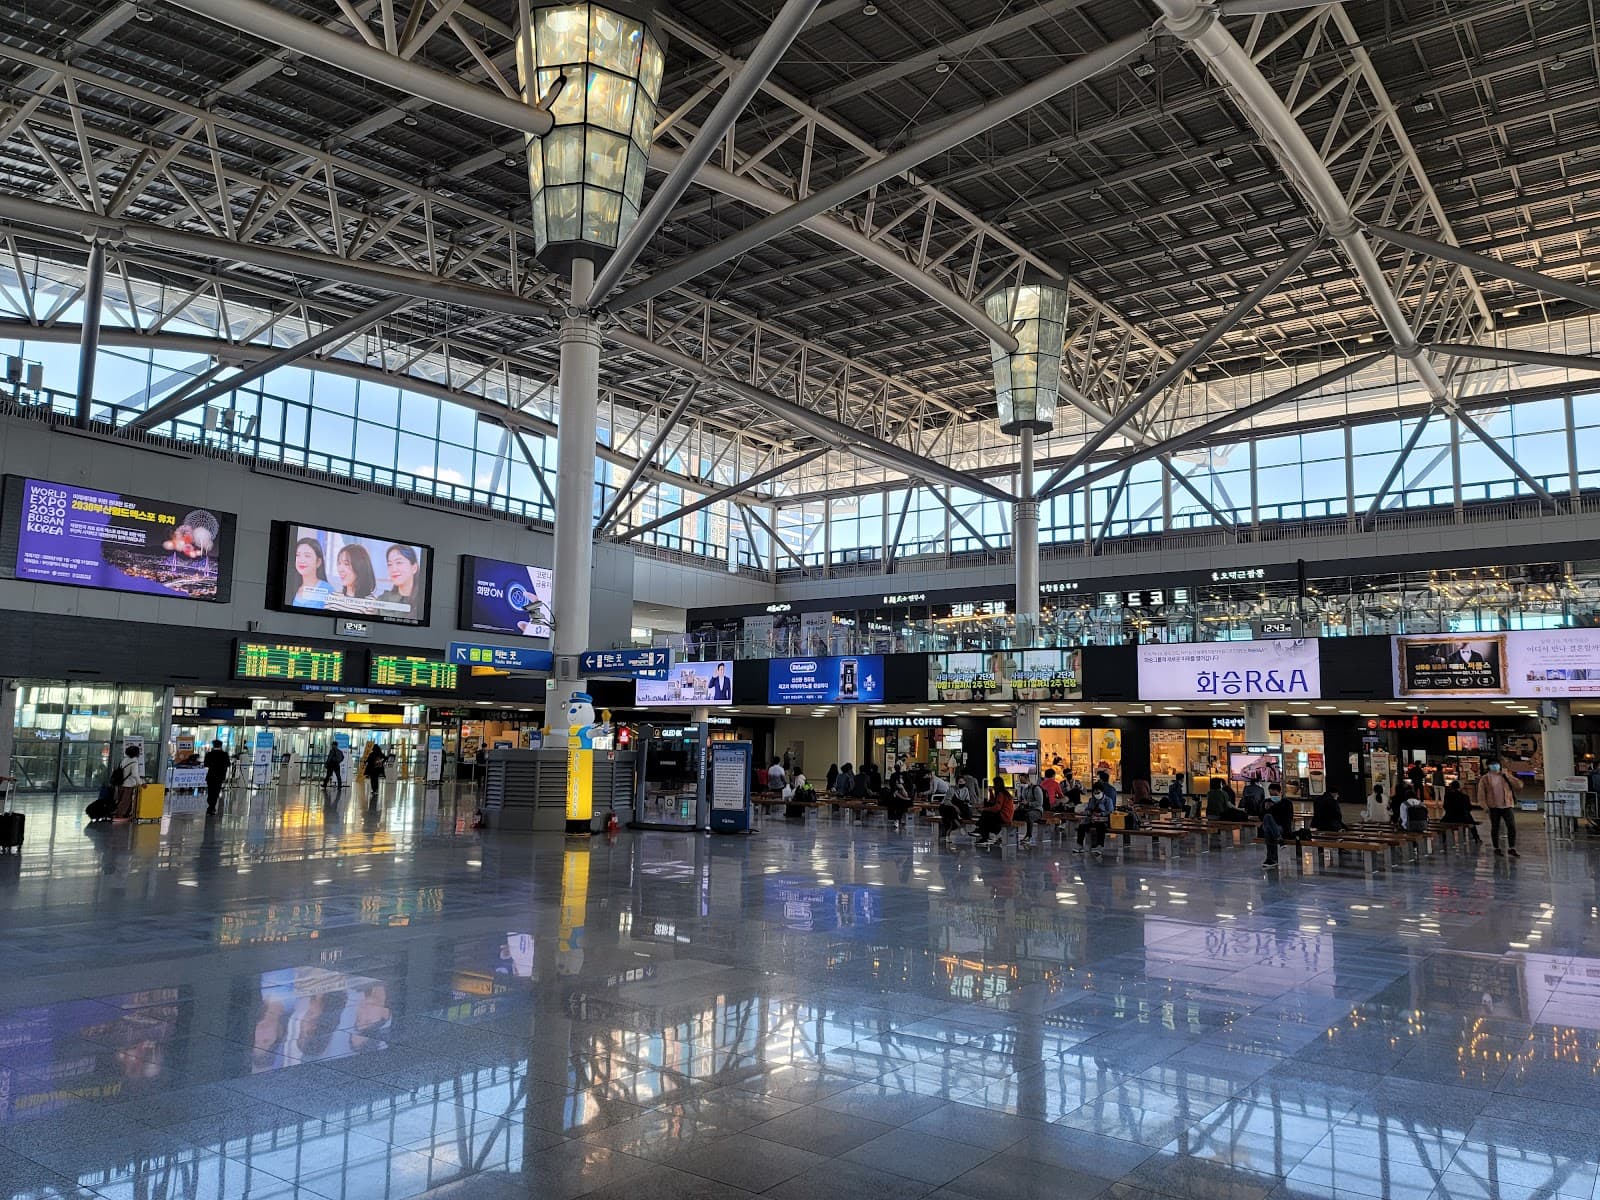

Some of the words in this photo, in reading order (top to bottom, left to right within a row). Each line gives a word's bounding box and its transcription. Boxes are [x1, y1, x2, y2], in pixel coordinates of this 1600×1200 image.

[31, 486, 67, 498] WORLD
[30, 494, 66, 508] EXPO
[29, 505, 65, 517] 2030
[28, 514, 64, 526] BUSAN
[158, 514, 176, 525] 유치
[27, 523, 63, 535] KOREA
[1104, 589, 1188, 607] 푸드코트
[951, 603, 974, 617] 김밥
[982, 601, 1006, 615] 국밥
[984, 680, 997, 689] 연장
[1063, 679, 1077, 688] 연장
[1196, 669, 1309, 695] 화승R&A
[905, 718, 912, 726] &
[913, 718, 942, 726] COFFEE
[1047, 718, 1081, 726] FRIENDS
[1422, 719, 1490, 729] PASCUCCI
